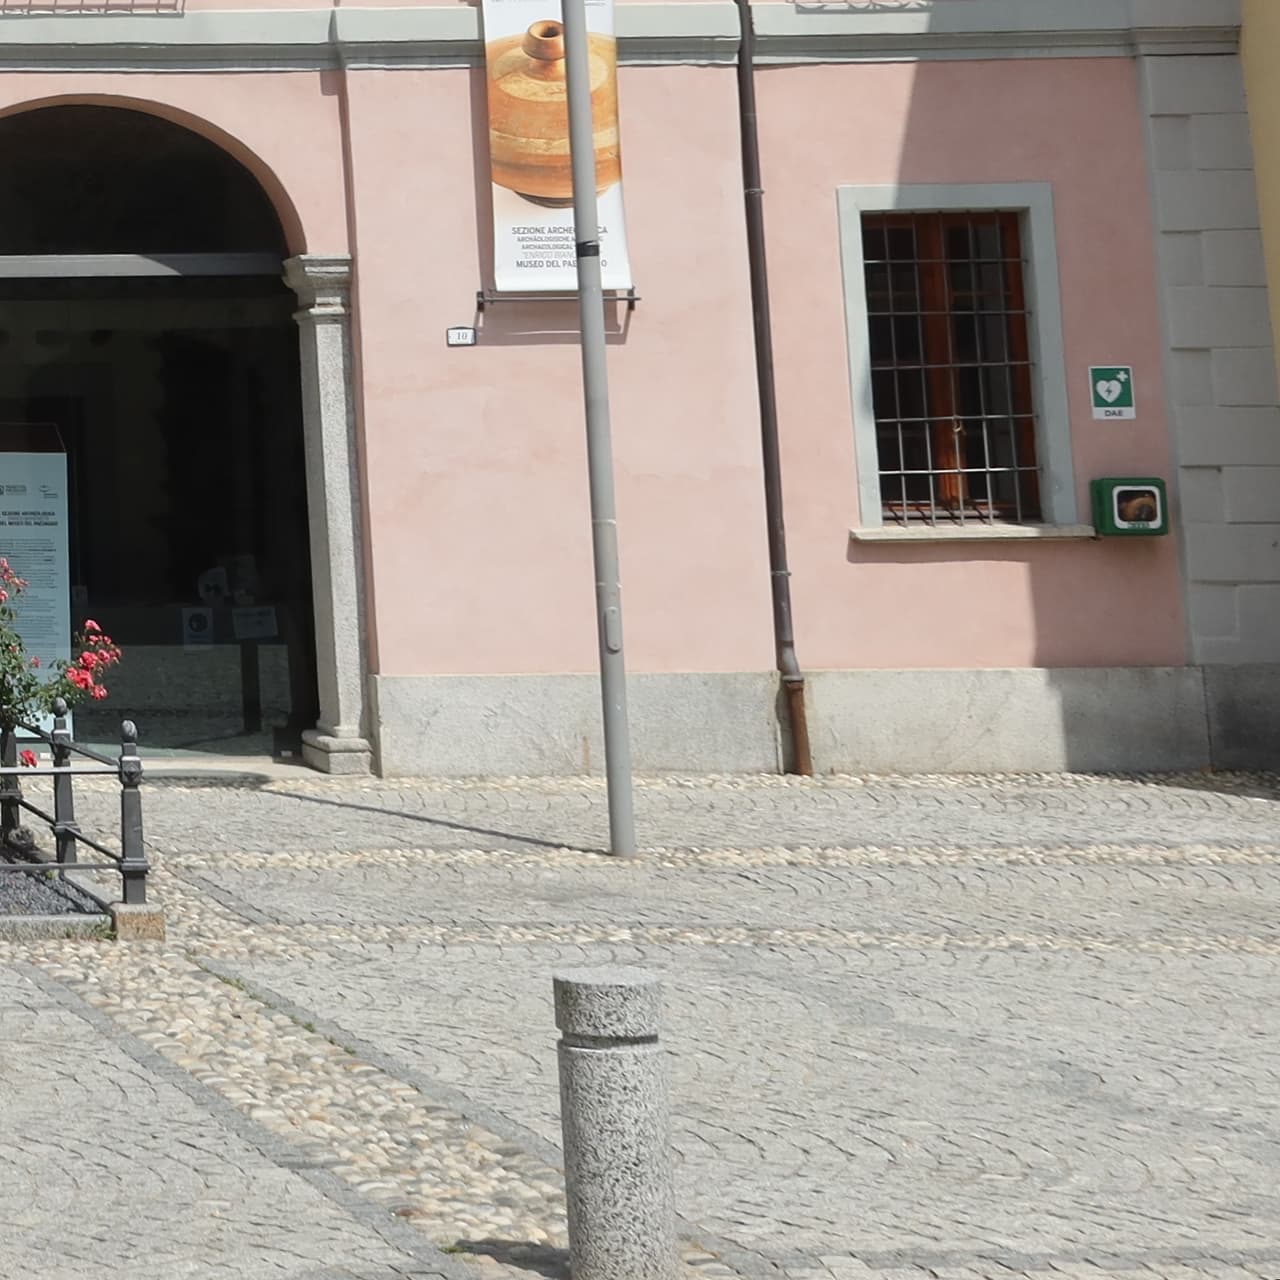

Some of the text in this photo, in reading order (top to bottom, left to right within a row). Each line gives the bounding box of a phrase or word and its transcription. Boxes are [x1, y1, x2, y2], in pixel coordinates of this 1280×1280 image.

[512, 227, 545, 235] SEZIONE
[516, 260, 544, 268] MUSEO
[546, 260, 561, 268] DEL
[1104, 409, 1124, 417] DAE
